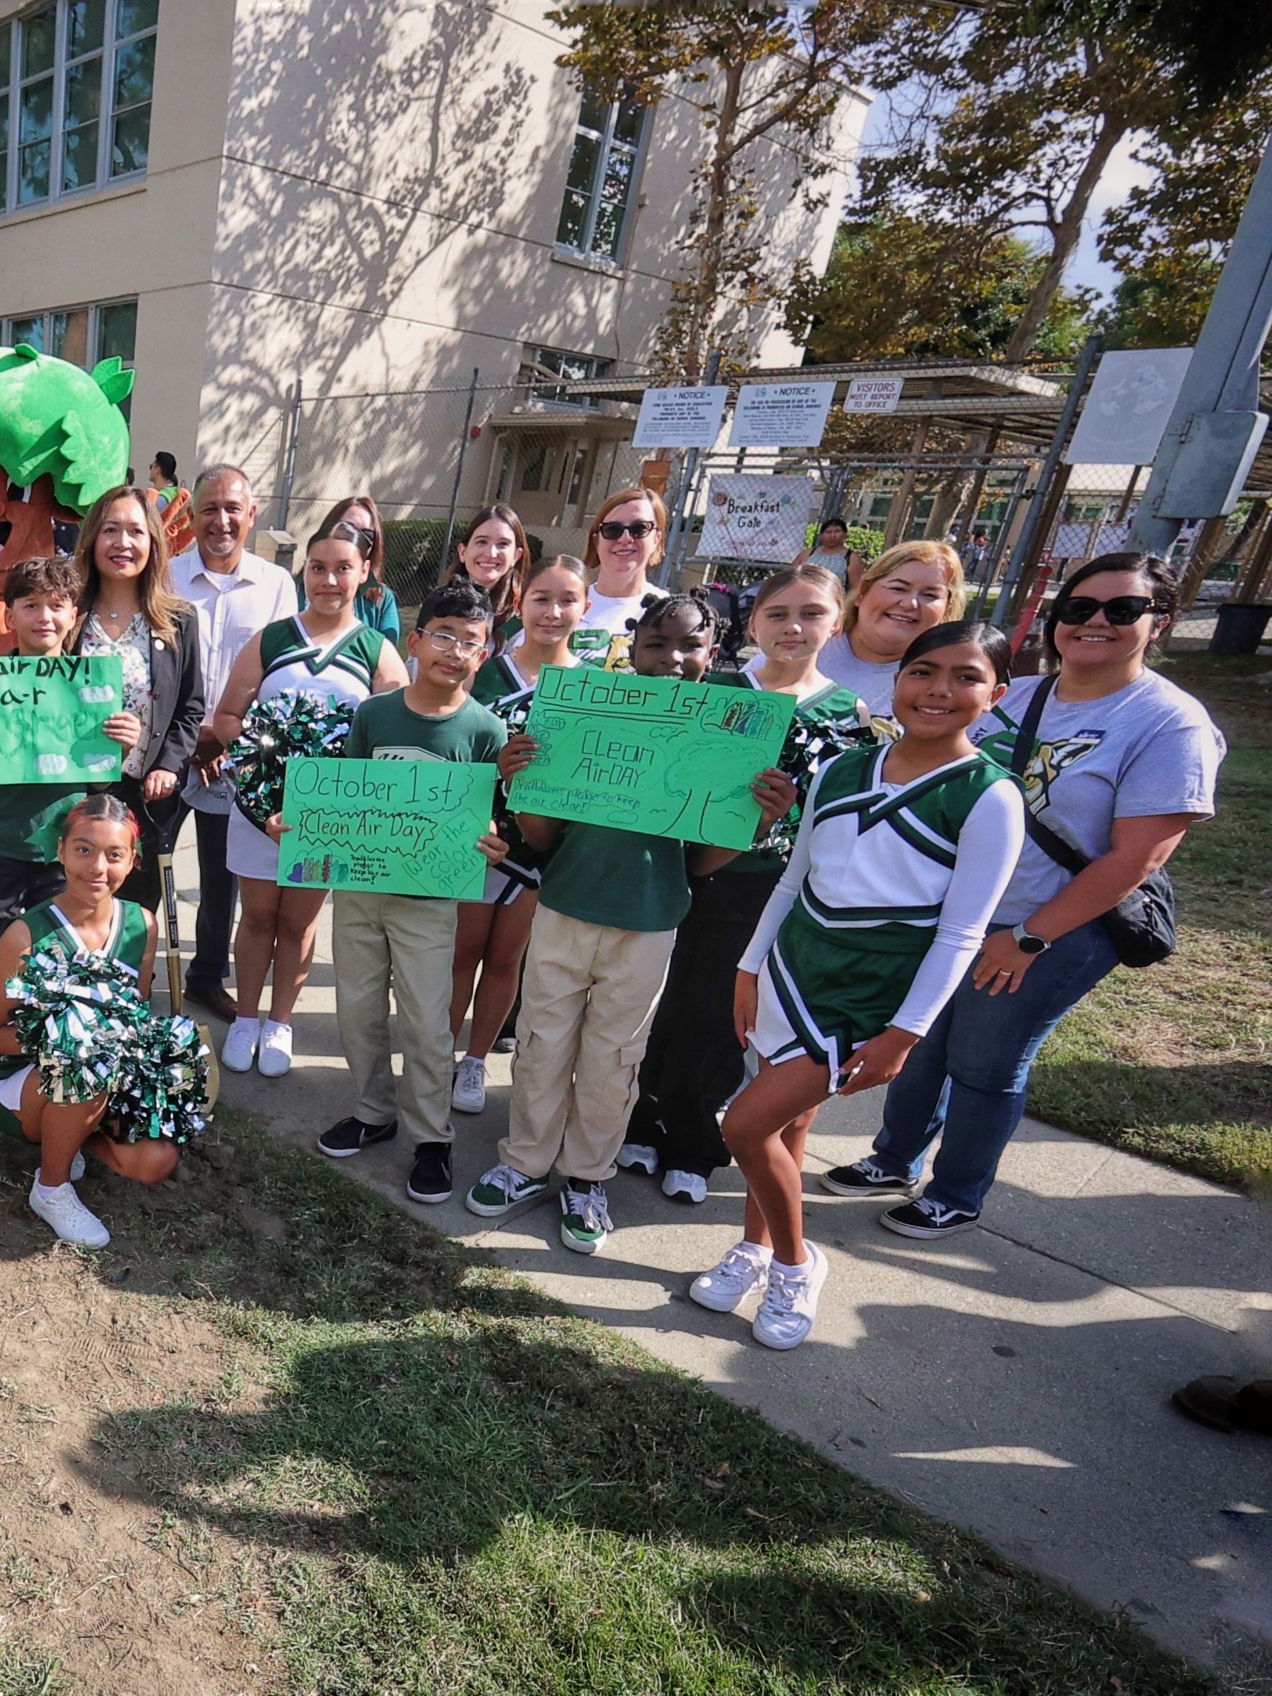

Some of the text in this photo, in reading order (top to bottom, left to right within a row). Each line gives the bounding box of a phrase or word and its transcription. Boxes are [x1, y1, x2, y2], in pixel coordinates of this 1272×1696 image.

[678, 391, 705, 400] NOTICE
[779, 387, 811, 396] NOTICE
[857, 383, 895, 392] VISITORS
[728, 498, 780, 515] Breakfast
[738, 516, 761, 528] Gate
[36, 657, 90, 685] DAY!
[539, 667, 711, 716] October 1st
[294, 761, 454, 804] October 1st
[304, 811, 425, 850] Clean Air Day
[442, 821, 471, 842] the
[430, 842, 469, 879] color
